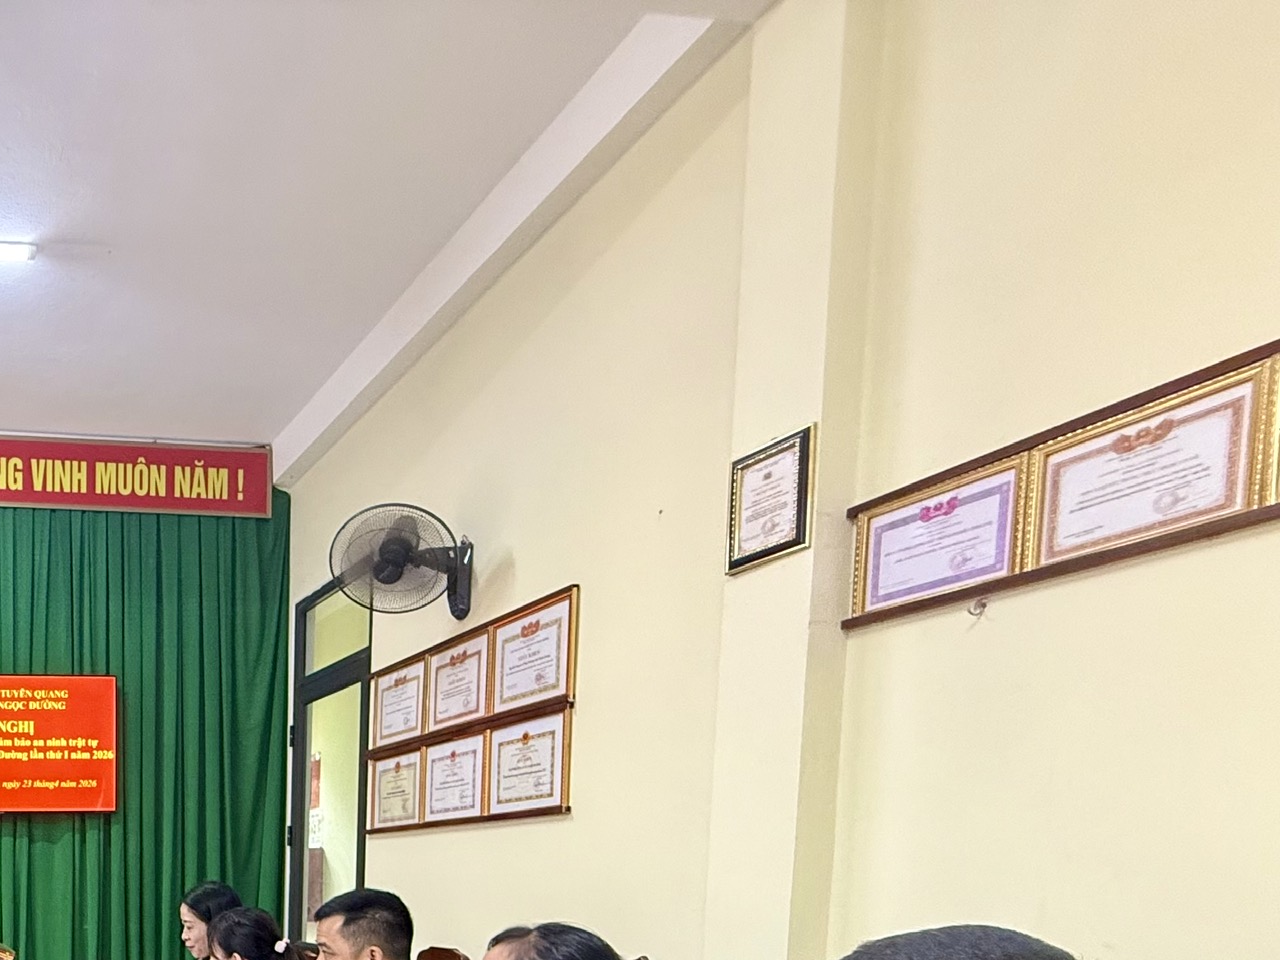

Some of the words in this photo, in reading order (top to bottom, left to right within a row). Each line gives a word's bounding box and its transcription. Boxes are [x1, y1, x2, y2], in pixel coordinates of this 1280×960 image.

[30, 458, 87, 493] VINH
[95, 456, 167, 497] MUÔN
[174, 459, 228, 500] NĂM
[237, 468, 245, 501] !
[0, 687, 33, 699] TUYÊN
[33, 689, 69, 700] QUANG
[14, 737, 31, 747] bảo
[32, 739, 44, 747] an
[46, 737, 67, 747] ninh
[68, 737, 86, 749] trật
[87, 738, 99, 749] tự
[30, 747, 44, 760] lần
[46, 749, 63, 760] thứ
[70, 749, 91, 760] năm
[92, 750, 114, 760] 2026
[2, 779, 21, 790] ngày
[60, 779, 77, 788] năm
[78, 779, 97, 788] 2026
